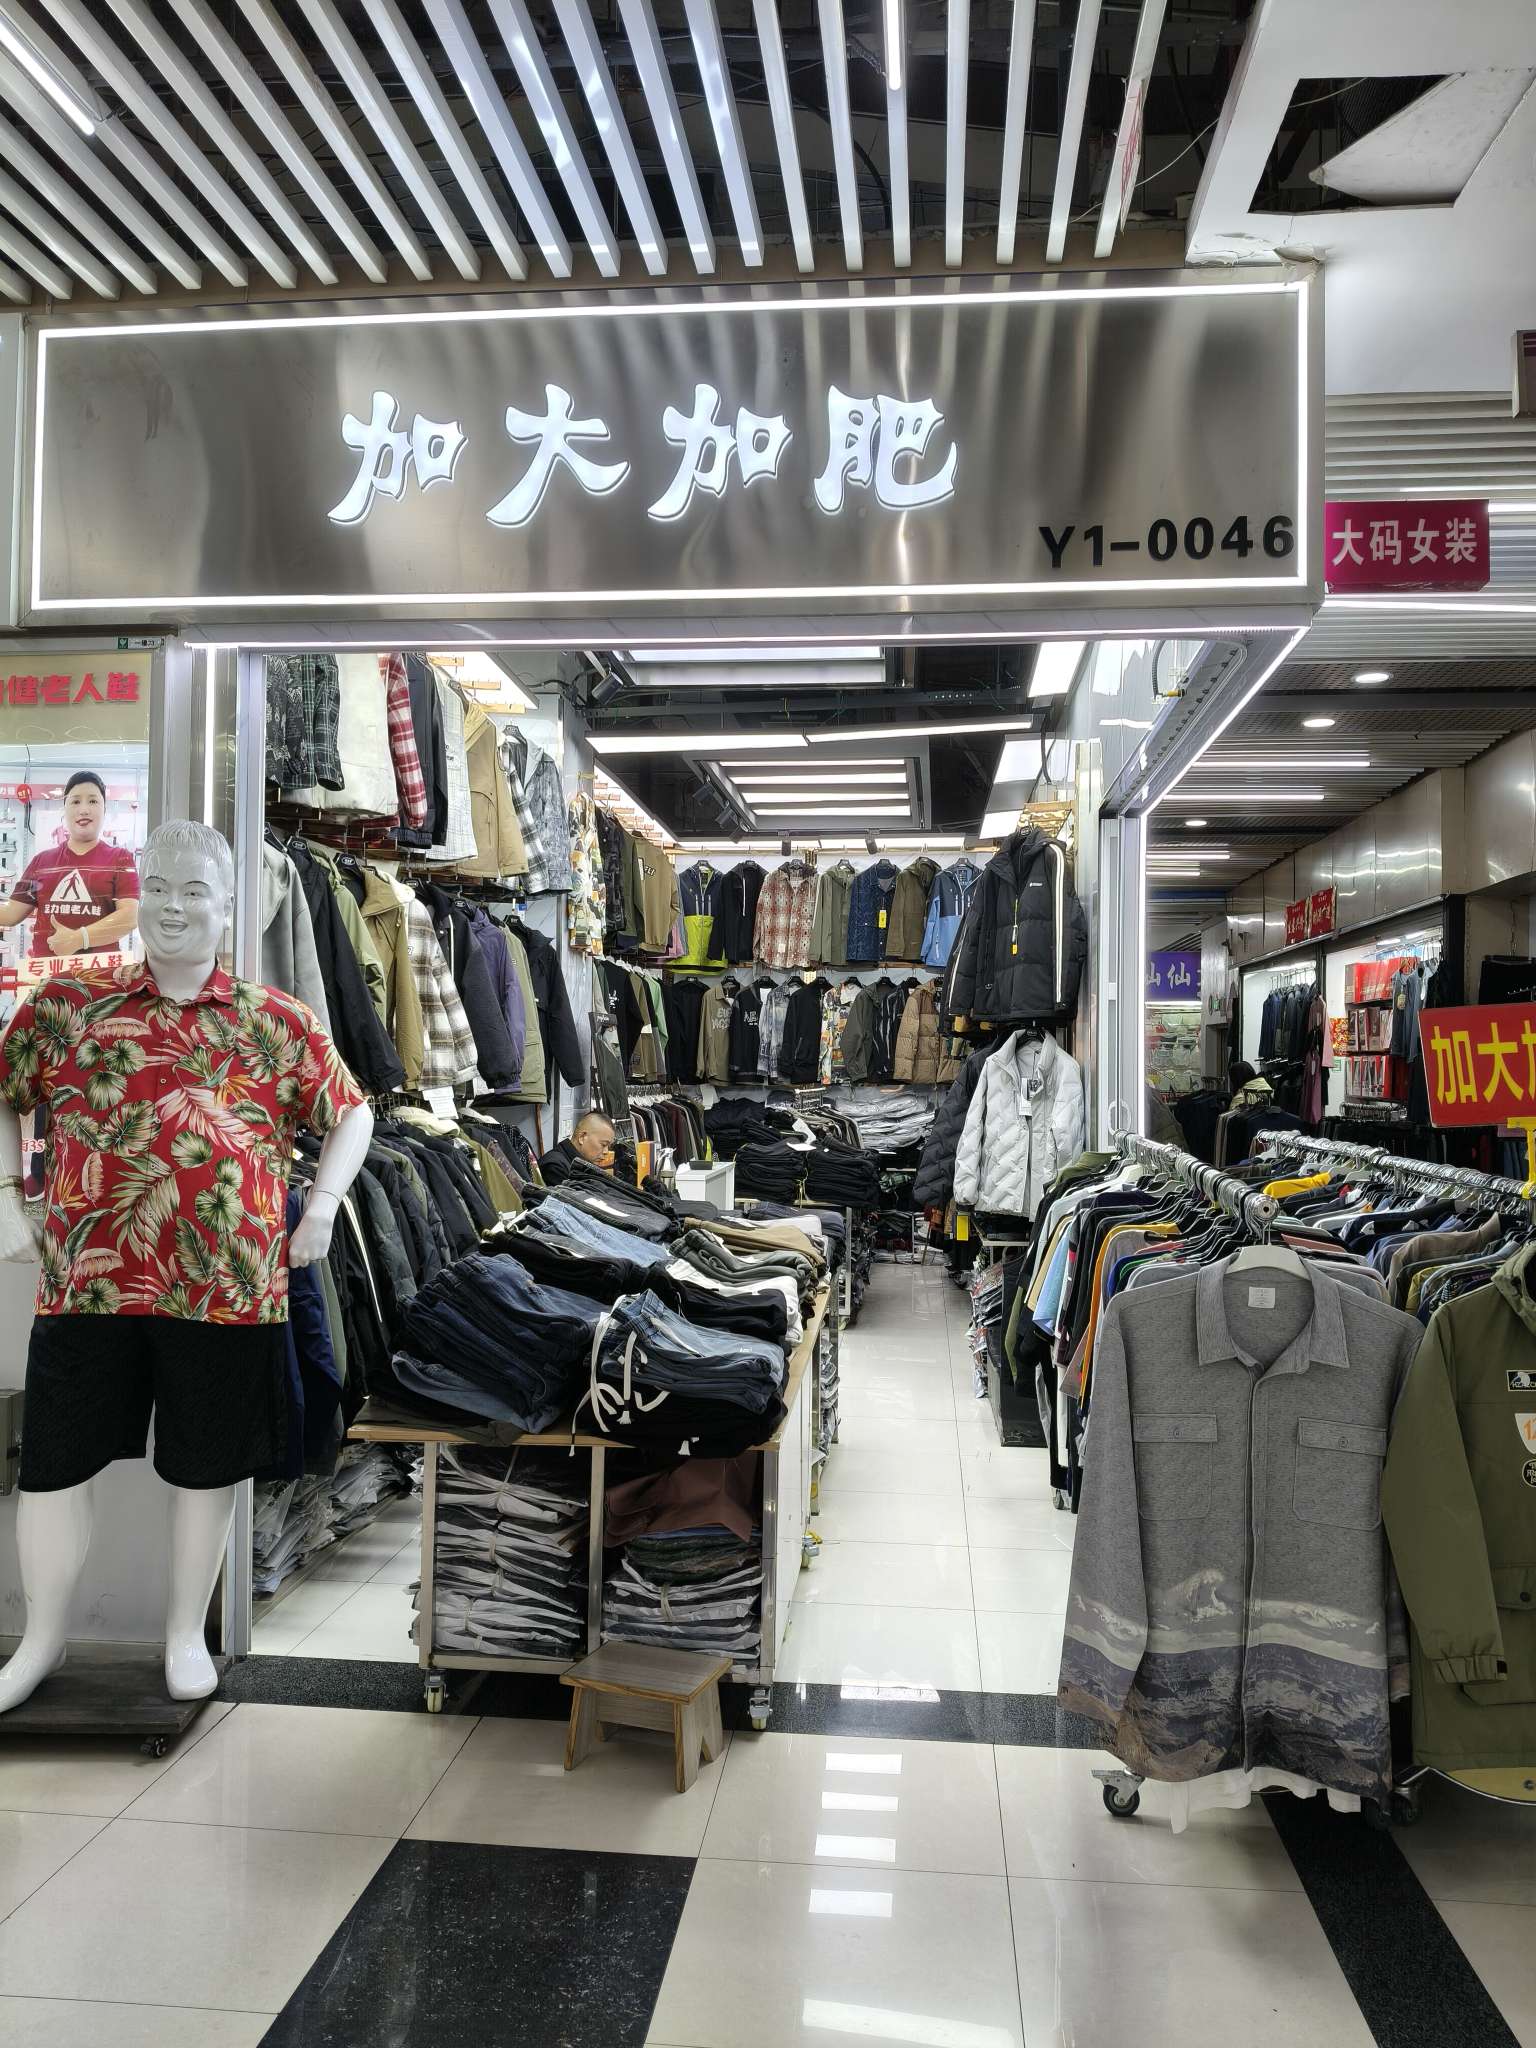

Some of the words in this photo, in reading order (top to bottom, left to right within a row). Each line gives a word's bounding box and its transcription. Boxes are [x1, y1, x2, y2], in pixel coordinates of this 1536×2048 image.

[328, 384, 957, 527] 加大加肥
[1331, 518, 1479, 566] 大码女装
[0, 672, 140, 706] 健老人鞋
